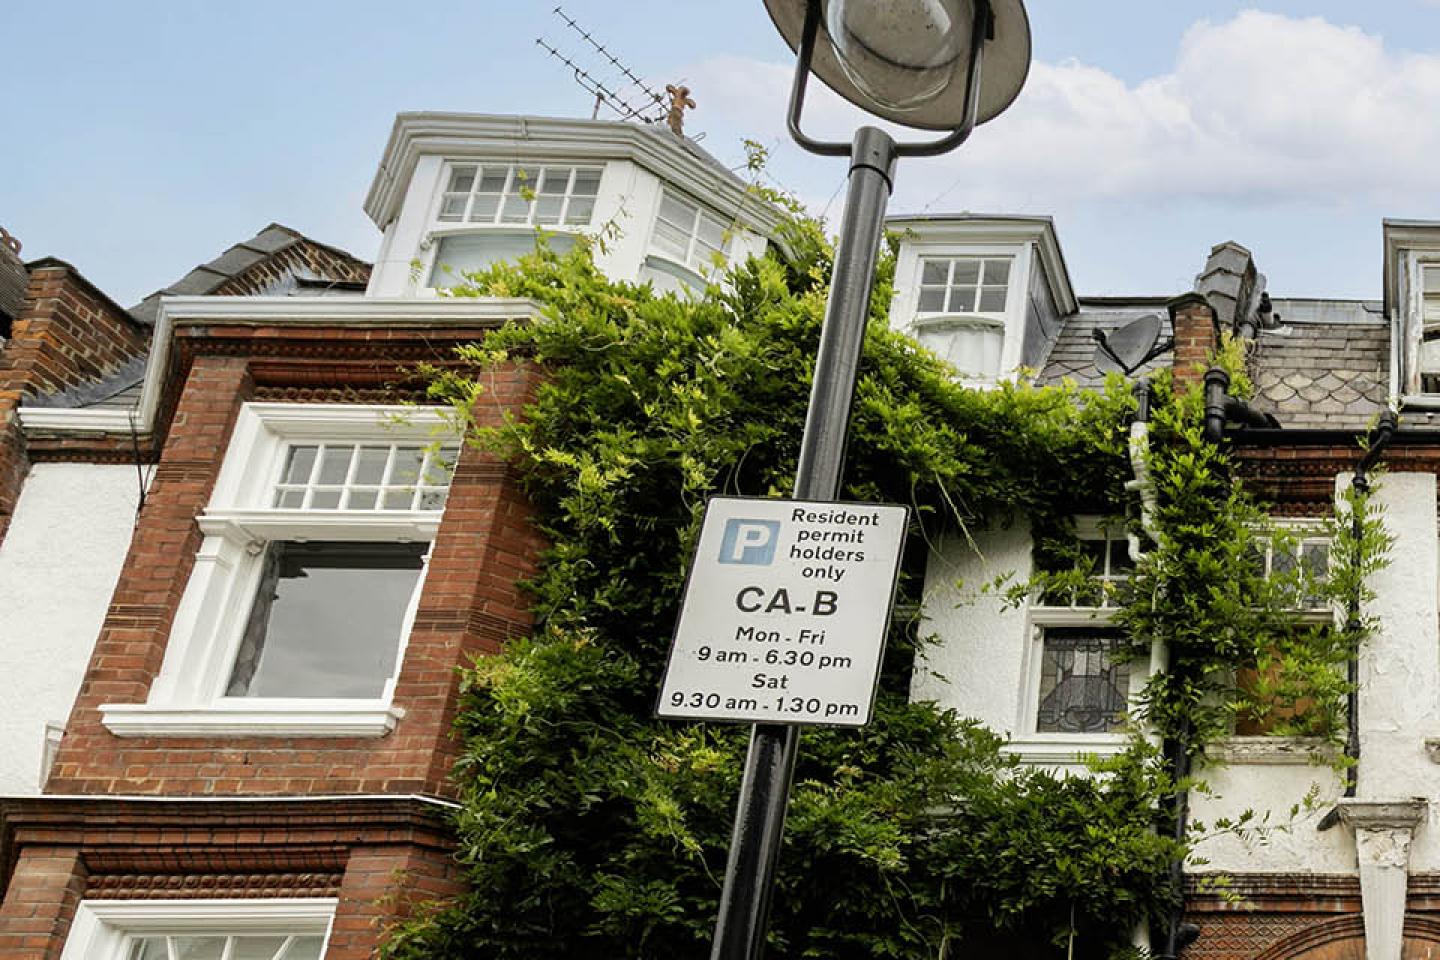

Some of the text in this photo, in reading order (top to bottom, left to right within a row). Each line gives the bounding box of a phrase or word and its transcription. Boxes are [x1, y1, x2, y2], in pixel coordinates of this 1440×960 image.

[791, 508, 880, 526] Resident
[731, 523, 771, 562] P
[797, 529, 865, 544] permit
[789, 544, 865, 562] holders
[801, 564, 846, 581] only
[735, 586, 839, 616] CA-B
[735, 626, 780, 643] Mon
[798, 629, 826, 645] Fri
[697, 646, 711, 661] 9
[716, 650, 747, 663] am
[765, 649, 814, 667] 6.30
[818, 655, 852, 669] pm
[751, 673, 789, 689] Sat
[671, 692, 721, 709] 9.30
[725, 698, 757, 711] am
[776, 697, 820, 714] 1.30
[824, 701, 859, 718] pm
